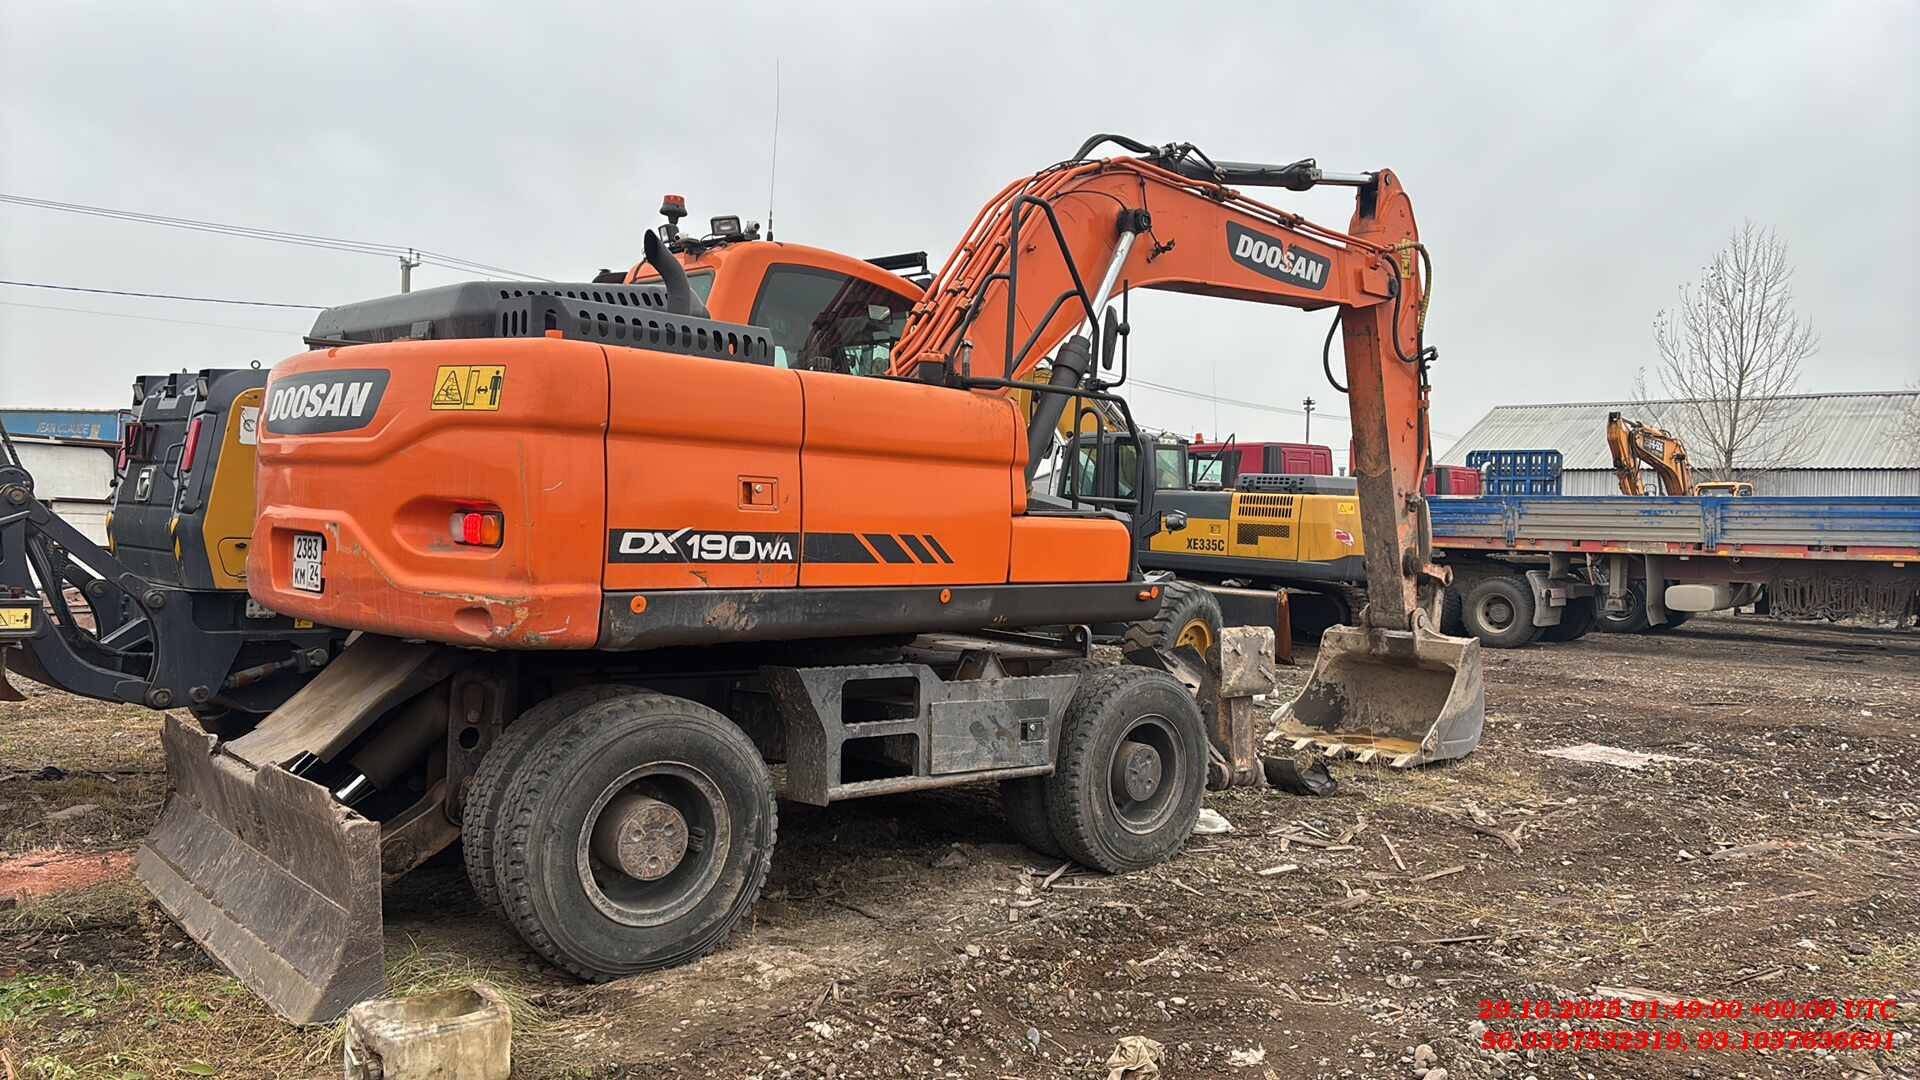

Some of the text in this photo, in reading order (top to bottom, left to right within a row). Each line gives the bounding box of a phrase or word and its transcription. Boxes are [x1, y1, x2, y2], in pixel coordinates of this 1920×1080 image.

[1235, 233, 1323, 284] DOOSAN
[269, 382, 373, 422] DOOSAN
[296, 537, 319, 560] 2383
[1186, 538, 1225, 551] XE335C
[309, 565, 319, 581] 24
